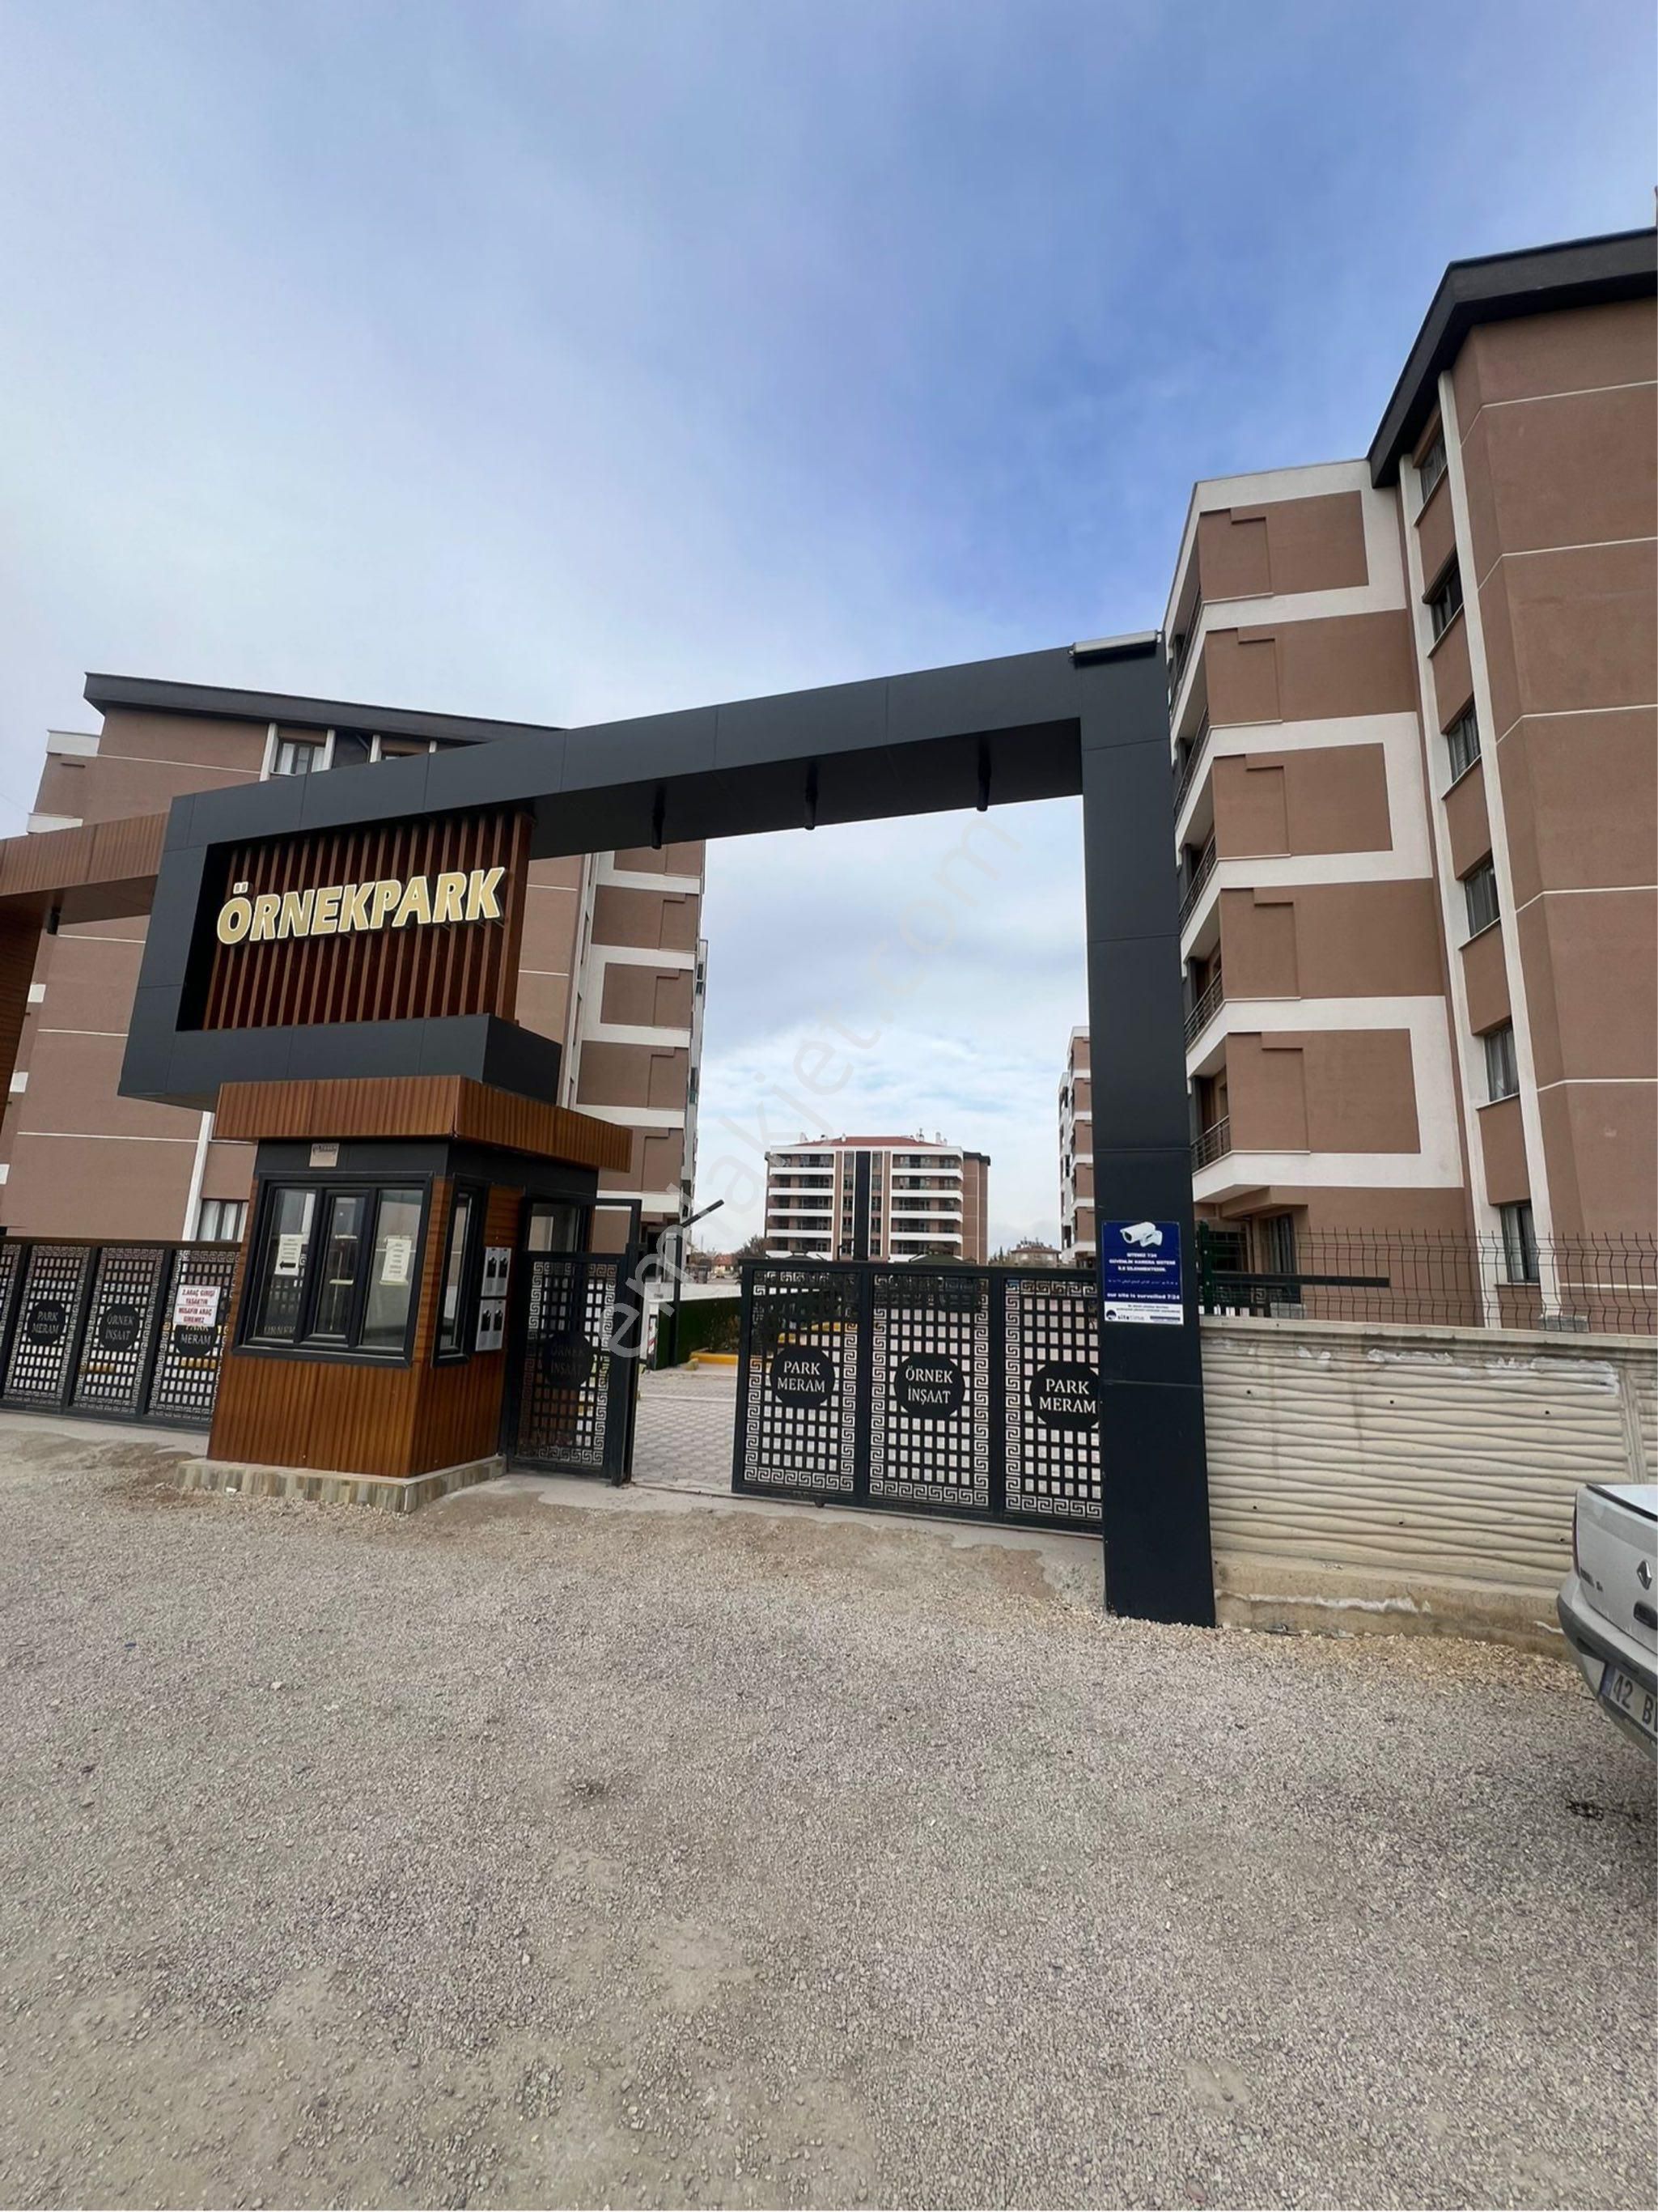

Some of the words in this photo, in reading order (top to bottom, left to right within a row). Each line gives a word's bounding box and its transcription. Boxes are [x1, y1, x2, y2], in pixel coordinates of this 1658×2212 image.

[216, 866, 505, 945] ÖRNEKPARK
[37, 1310, 59, 1322] PARK
[32, 1323, 59, 1335] MERAM
[180, 1333, 211, 1344] MERAM
[783, 1361, 821, 1376] PARK
[905, 1365, 953, 1384] ÖRNEK
[777, 1377, 825, 1393] MERAM
[1045, 1378, 1090, 1395] PARK
[907, 1386, 951, 1405] İNŞAAT
[1039, 1396, 1096, 1414] MERAM
[1613, 1675, 1633, 1709] 42
[1642, 1693, 1657, 1732] B
